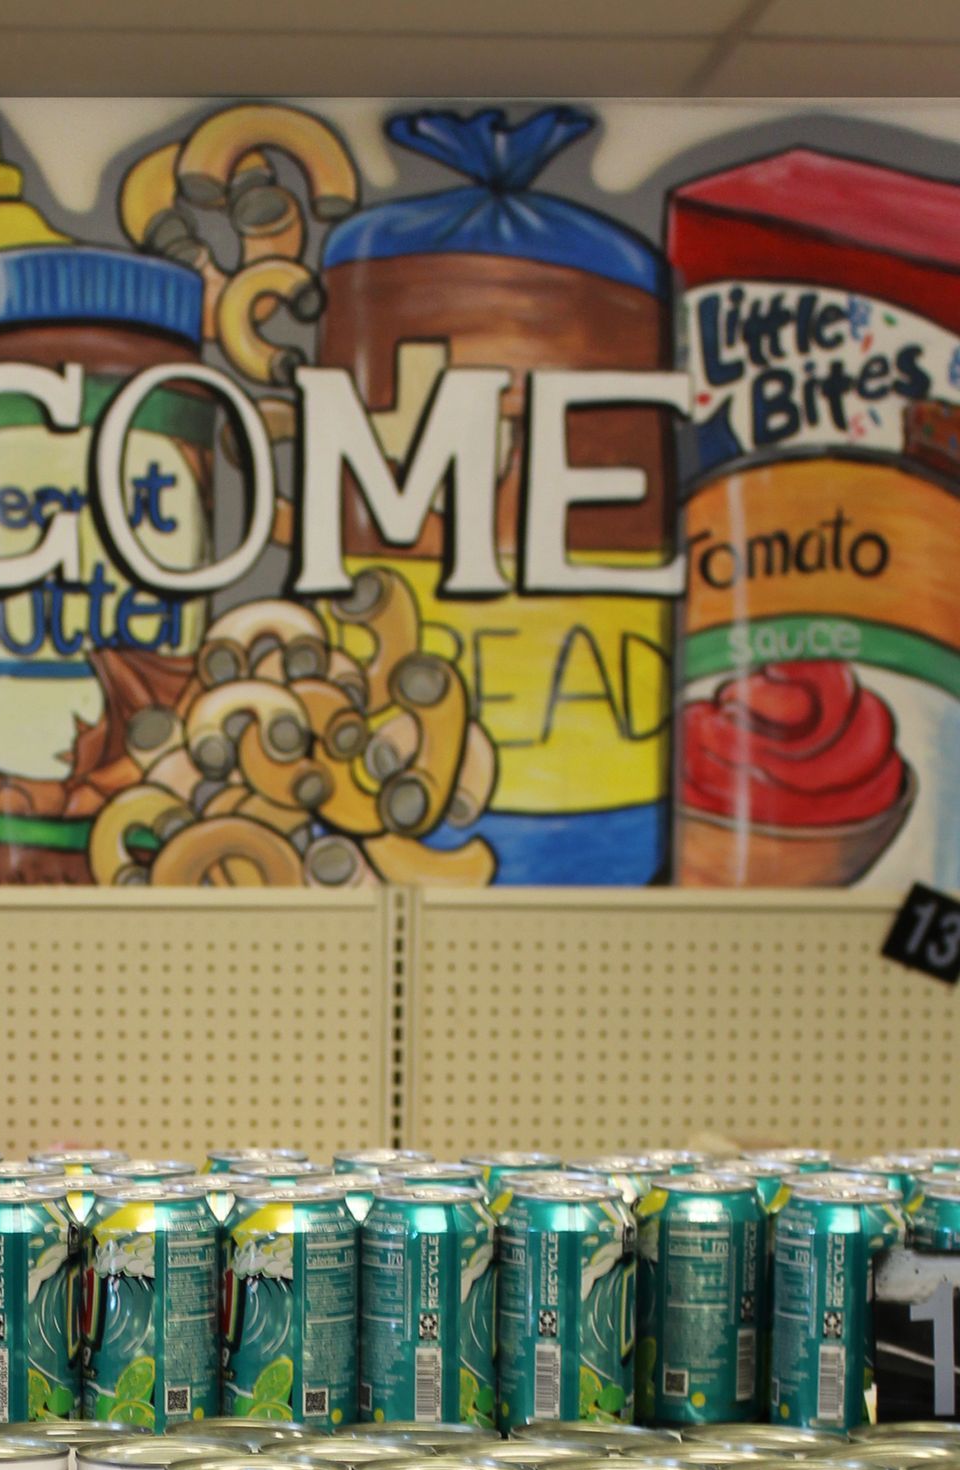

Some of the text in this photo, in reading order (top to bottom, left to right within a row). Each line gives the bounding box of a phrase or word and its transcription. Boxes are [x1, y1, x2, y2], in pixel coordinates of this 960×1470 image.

[697, 286, 848, 387] Little
[752, 343, 931, 445] Bites
[728, 621, 861, 666] sauce
[906, 902, 960, 967] 13
[428, 1234, 440, 1309] RECYCLE
[548, 1233, 559, 1306] RECYCLE
